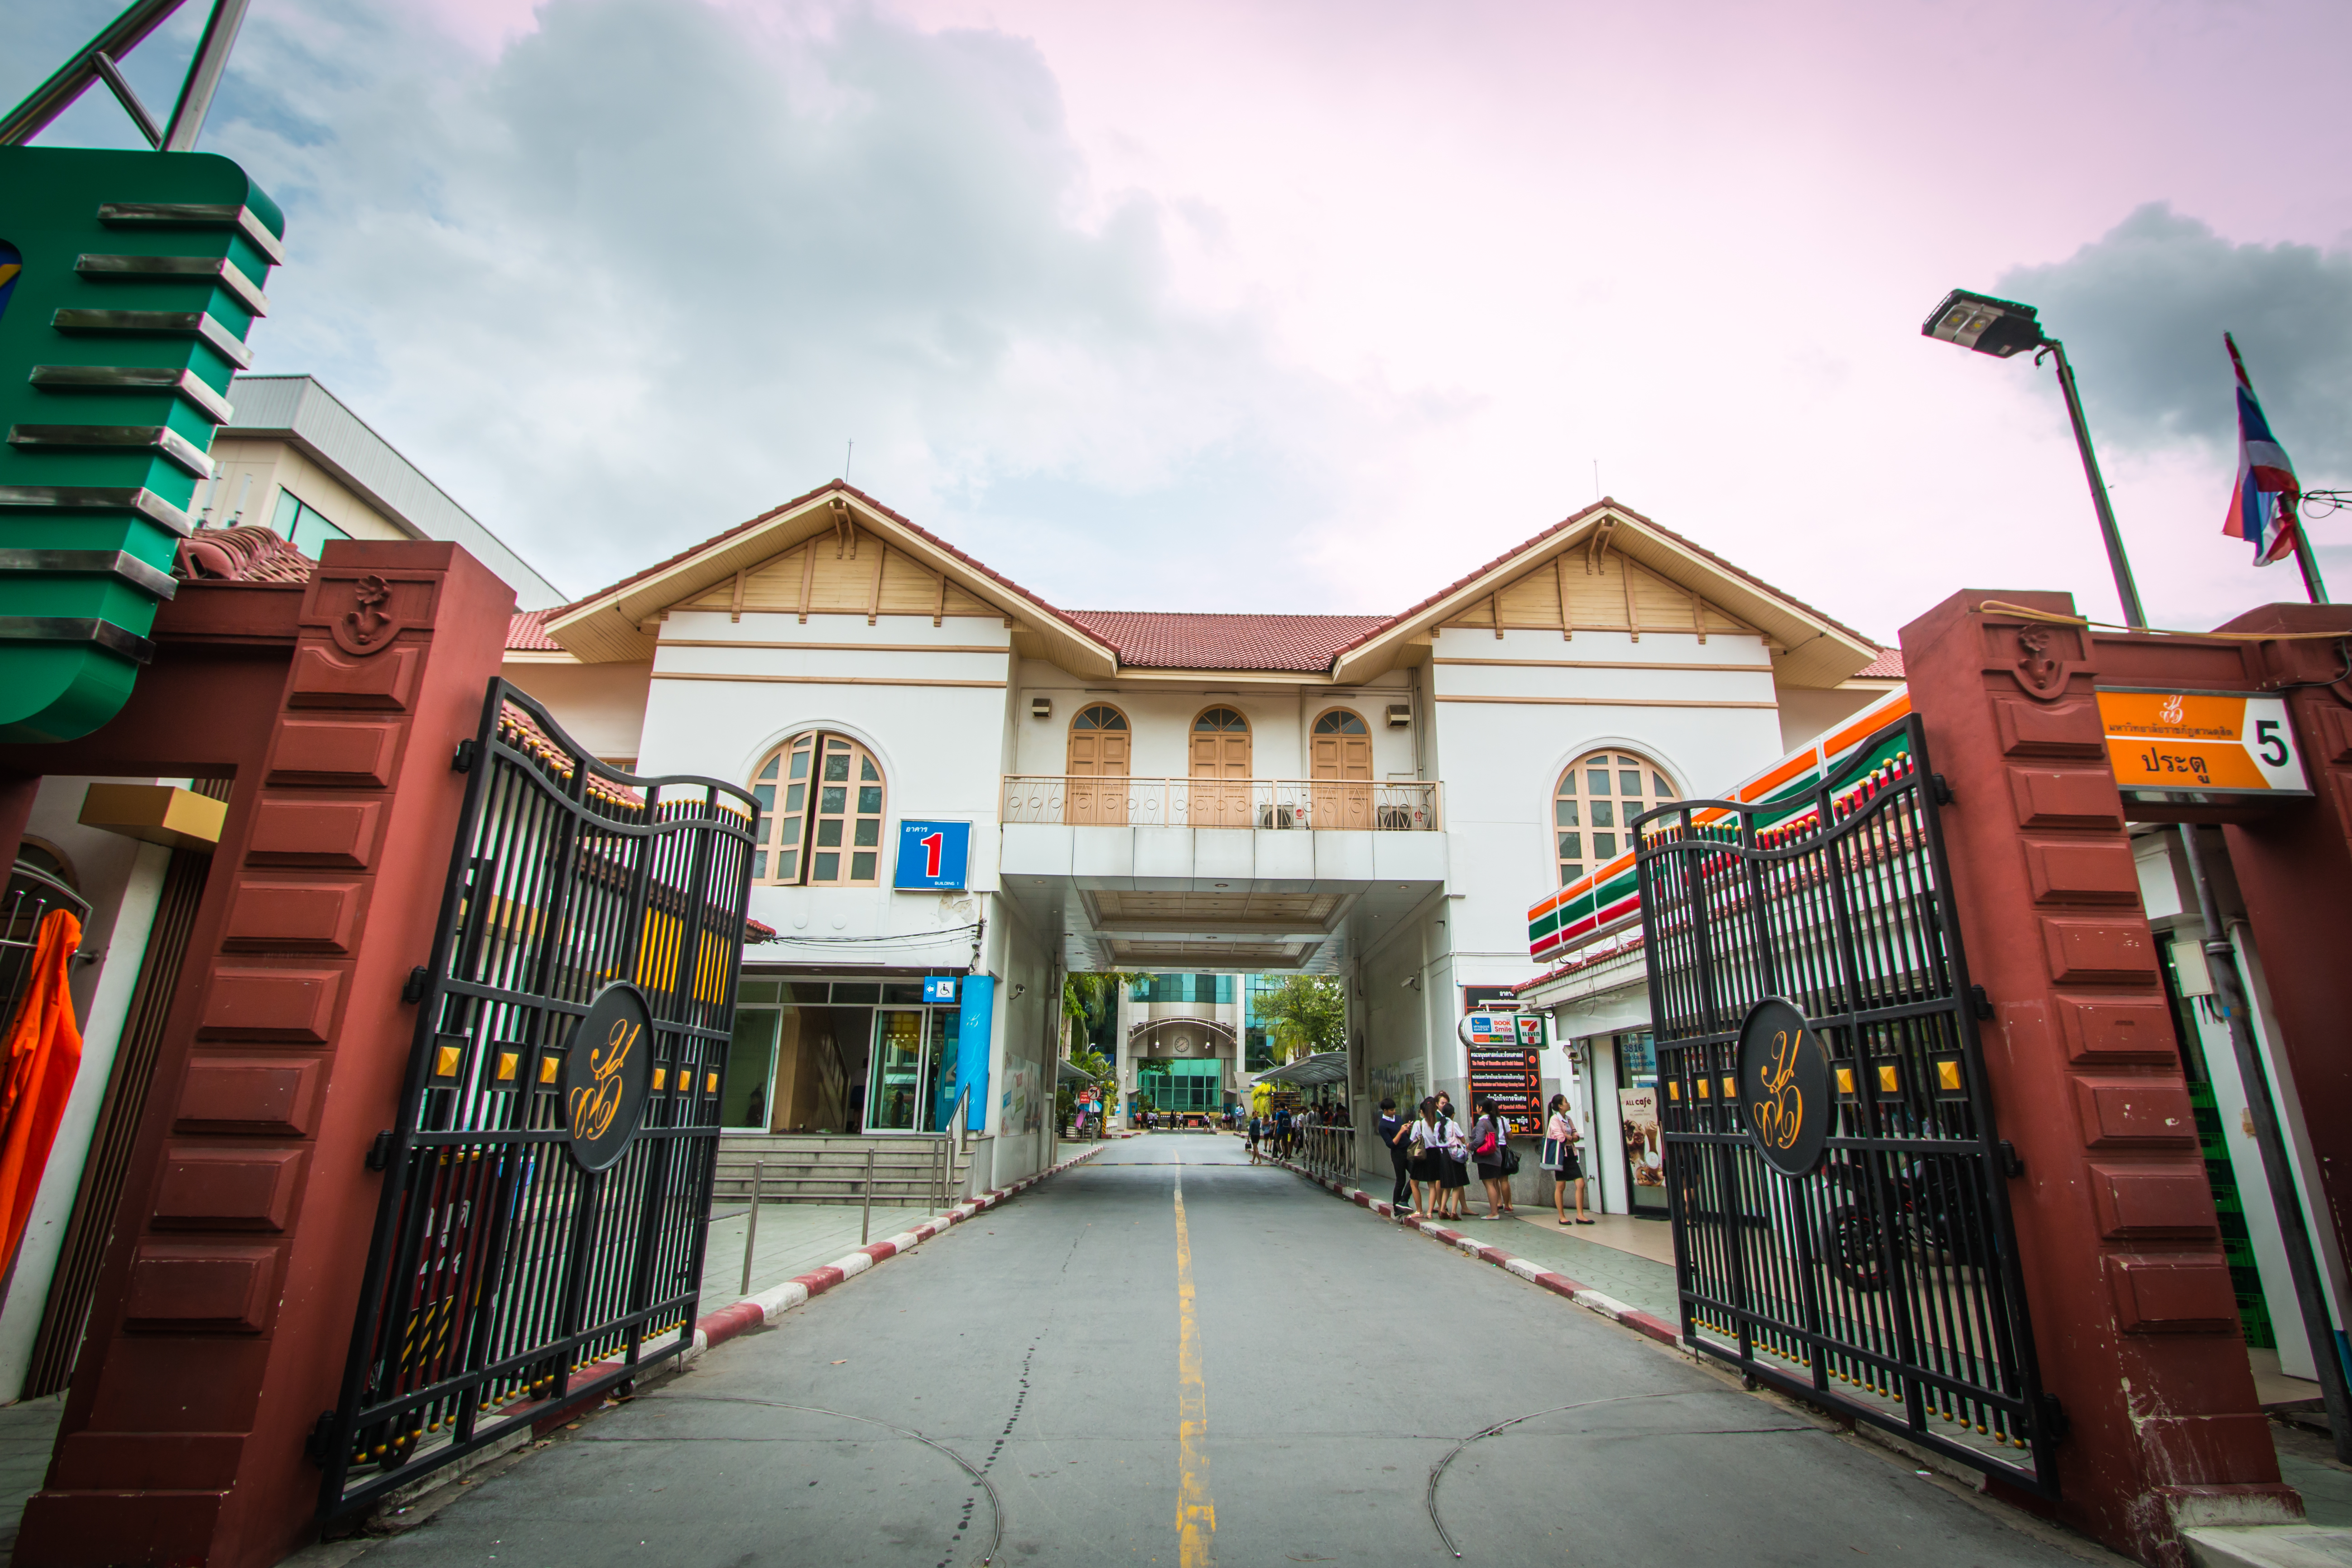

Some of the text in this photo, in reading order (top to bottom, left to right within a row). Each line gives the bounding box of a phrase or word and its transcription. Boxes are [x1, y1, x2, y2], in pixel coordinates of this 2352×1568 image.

[2256, 720, 2288, 767] 5
[2141, 747, 2210, 784] ประตู
[920, 832, 943, 877] 1
[1520, 1020, 1538, 1044] 7
[1623, 1044, 1644, 1053] 3816
[1635, 1097, 1651, 1108] café
